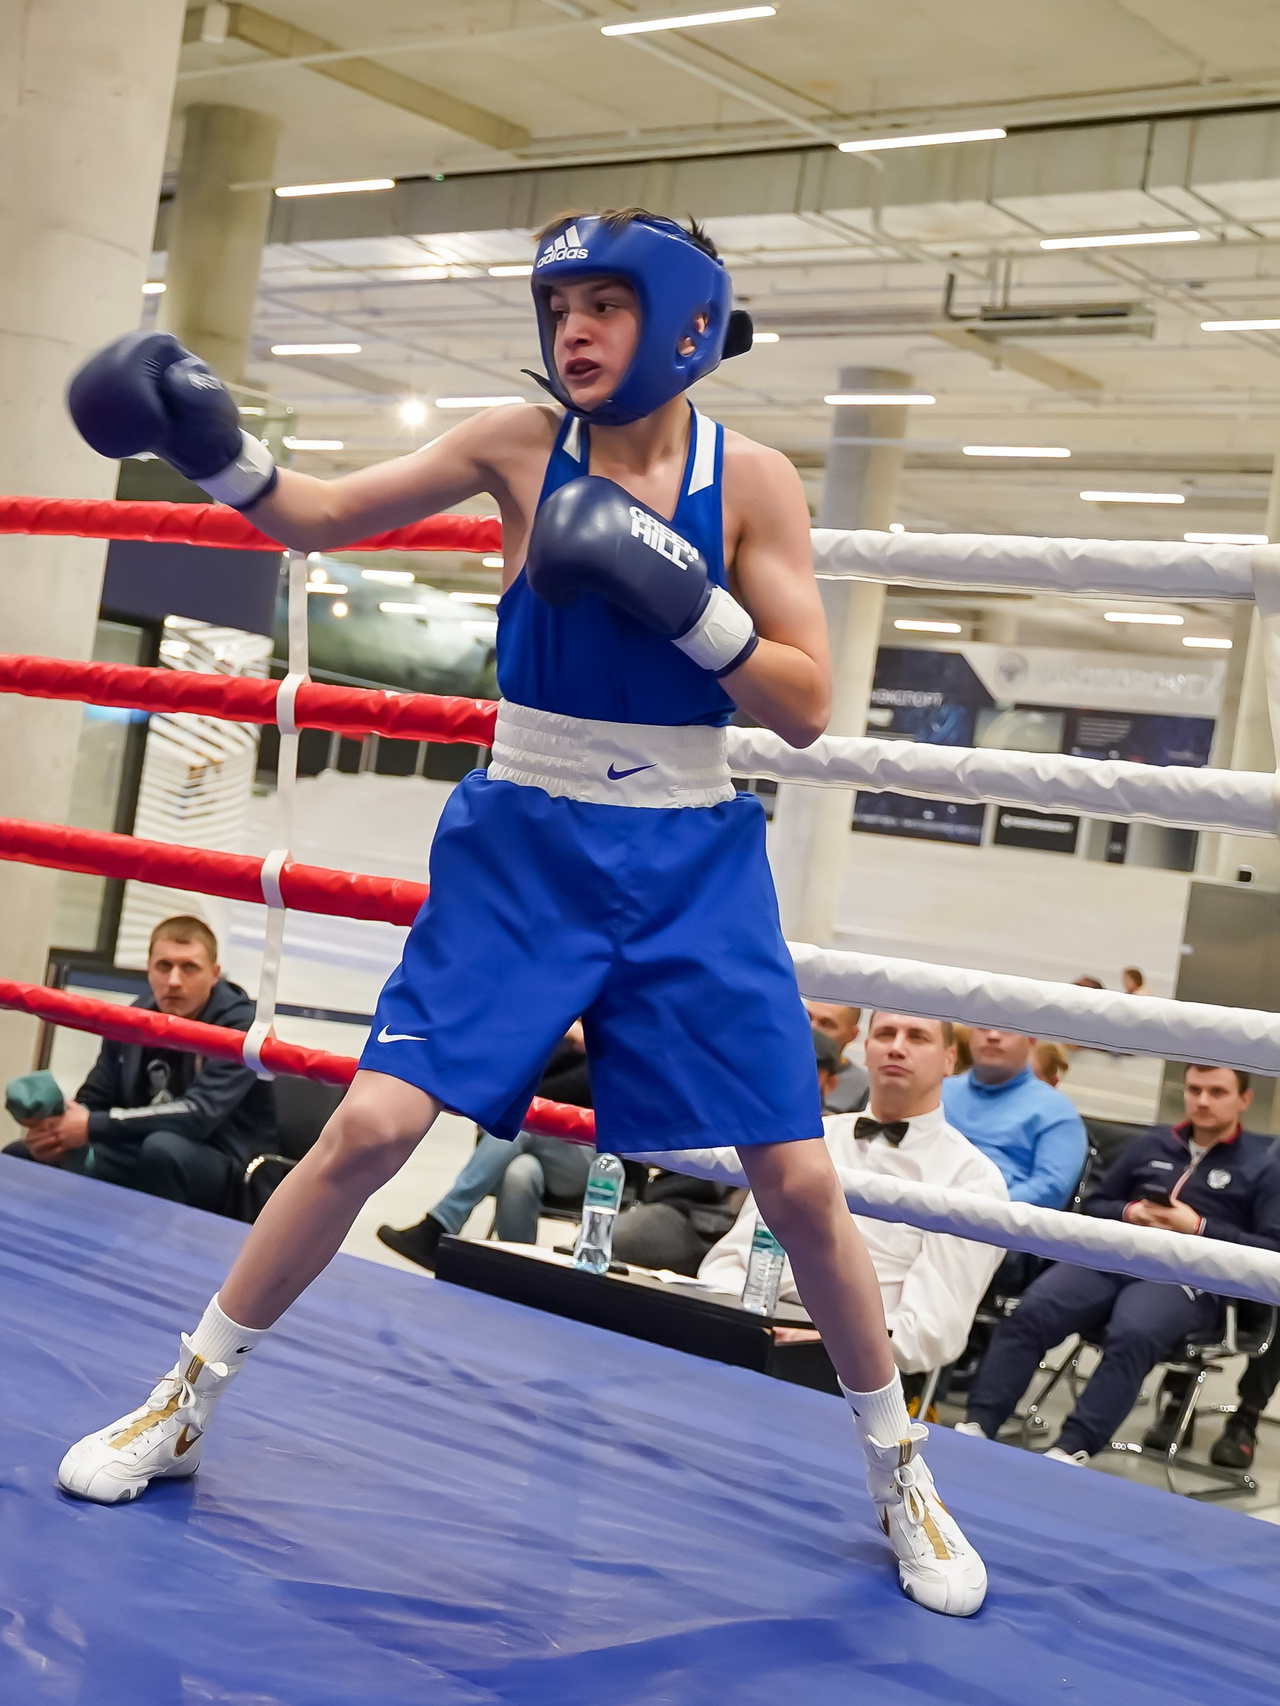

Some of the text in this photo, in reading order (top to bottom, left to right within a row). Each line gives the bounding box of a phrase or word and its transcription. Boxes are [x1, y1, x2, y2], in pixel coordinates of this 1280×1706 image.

[536, 246, 589, 269] adidas
[628, 505, 701, 561] GREEN
[630, 518, 688, 571] HILL
